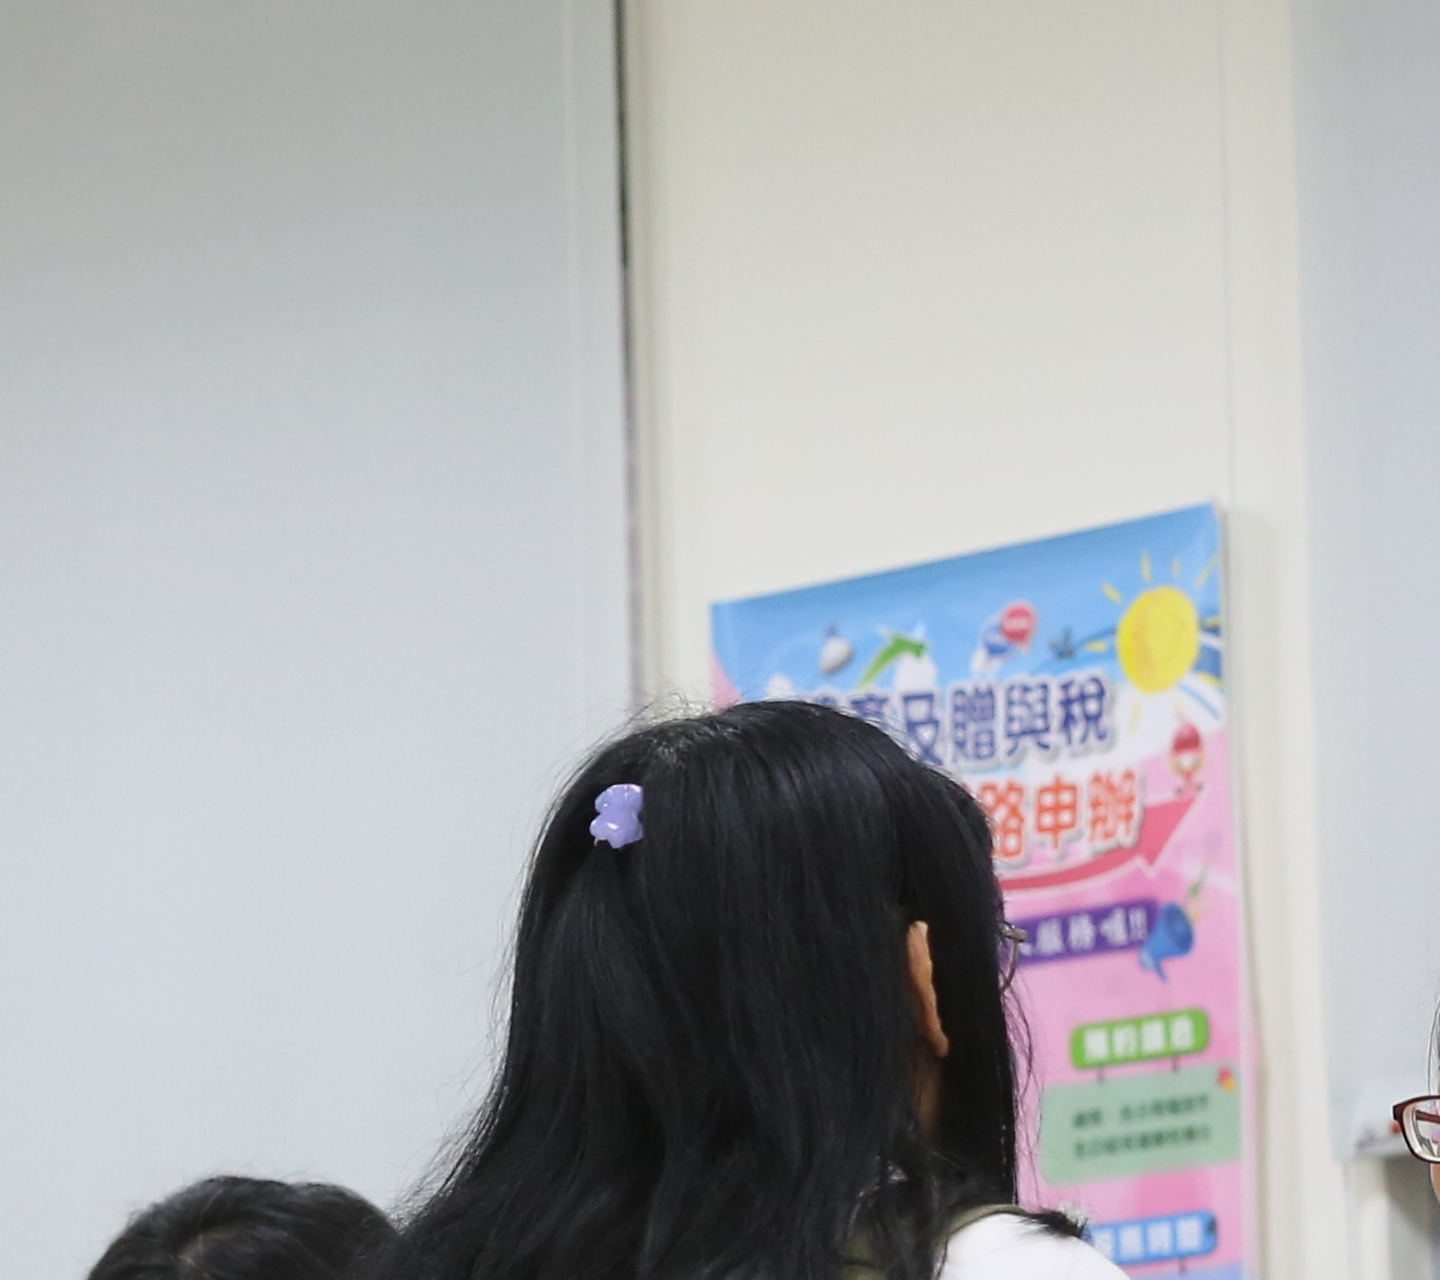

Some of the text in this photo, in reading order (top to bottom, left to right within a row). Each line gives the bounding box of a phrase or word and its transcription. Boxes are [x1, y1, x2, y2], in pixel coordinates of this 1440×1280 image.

[815, 677, 1108, 766] 及贈與稅
[962, 770, 1137, 858] 路申辦
